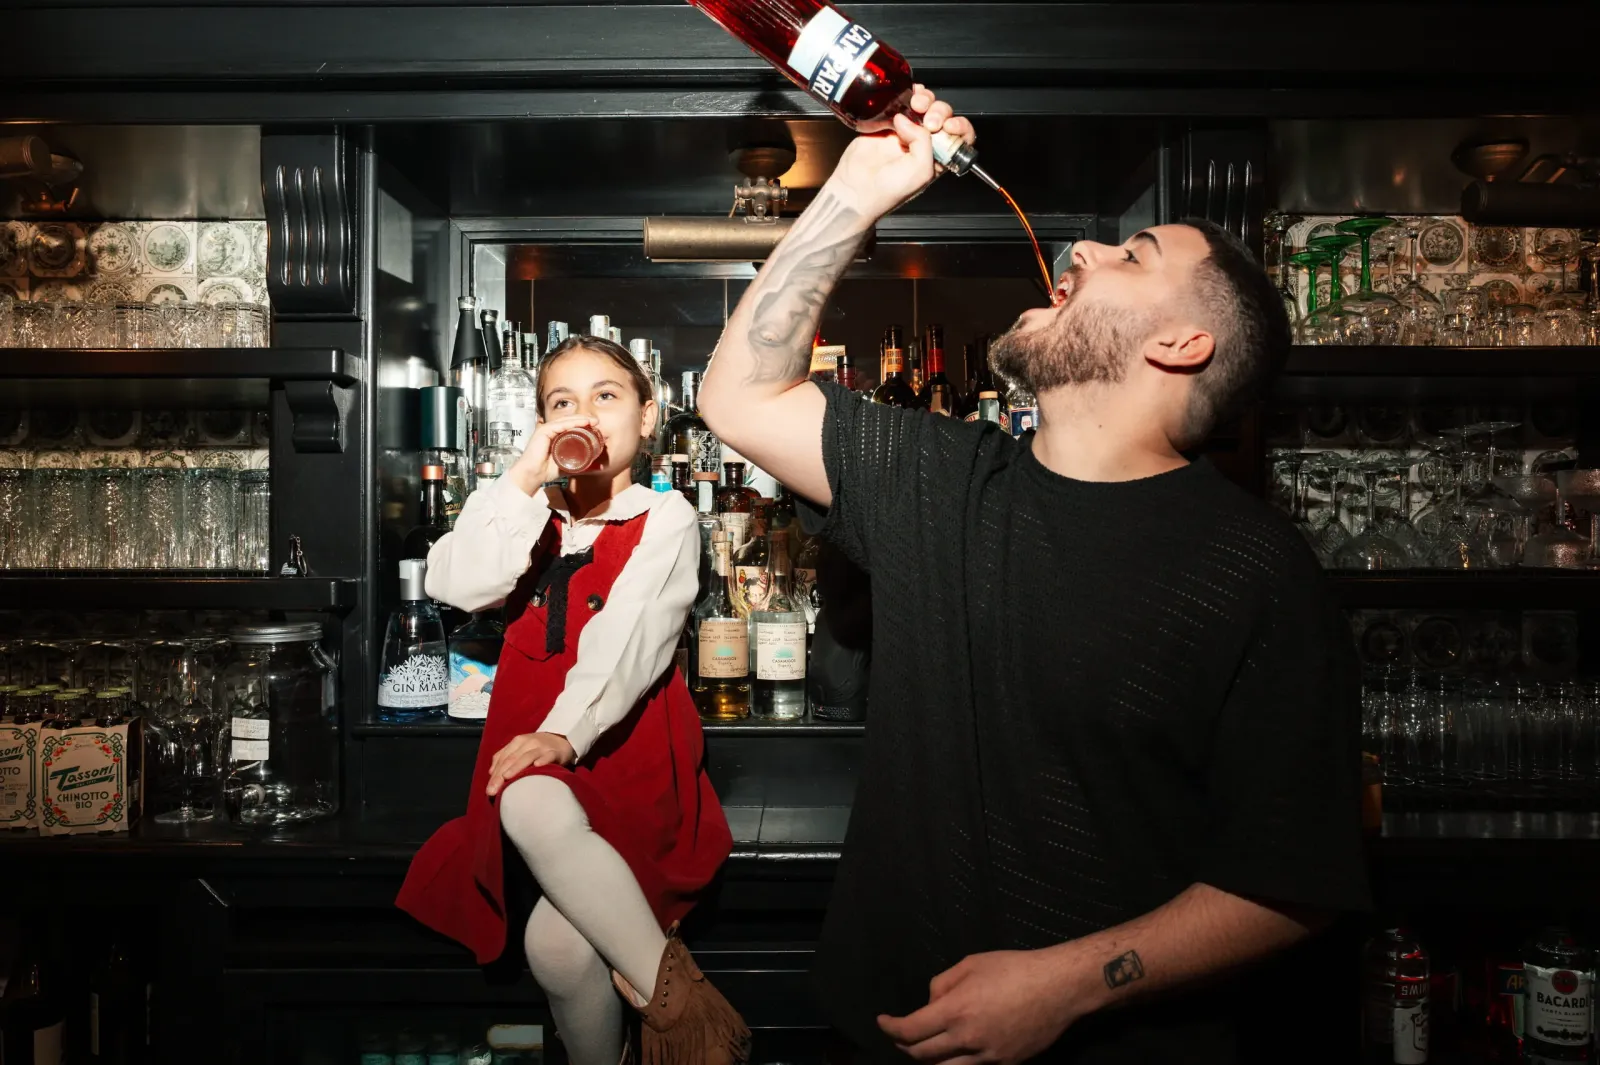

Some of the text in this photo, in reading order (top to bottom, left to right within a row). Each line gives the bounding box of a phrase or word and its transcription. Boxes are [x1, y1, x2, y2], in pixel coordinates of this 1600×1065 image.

[393, 681, 448, 692] GIN MARE
[50, 764, 115, 791] Tassoni
[57, 791, 109, 802] CHINOTTO
[75, 801, 92, 809] BIO
